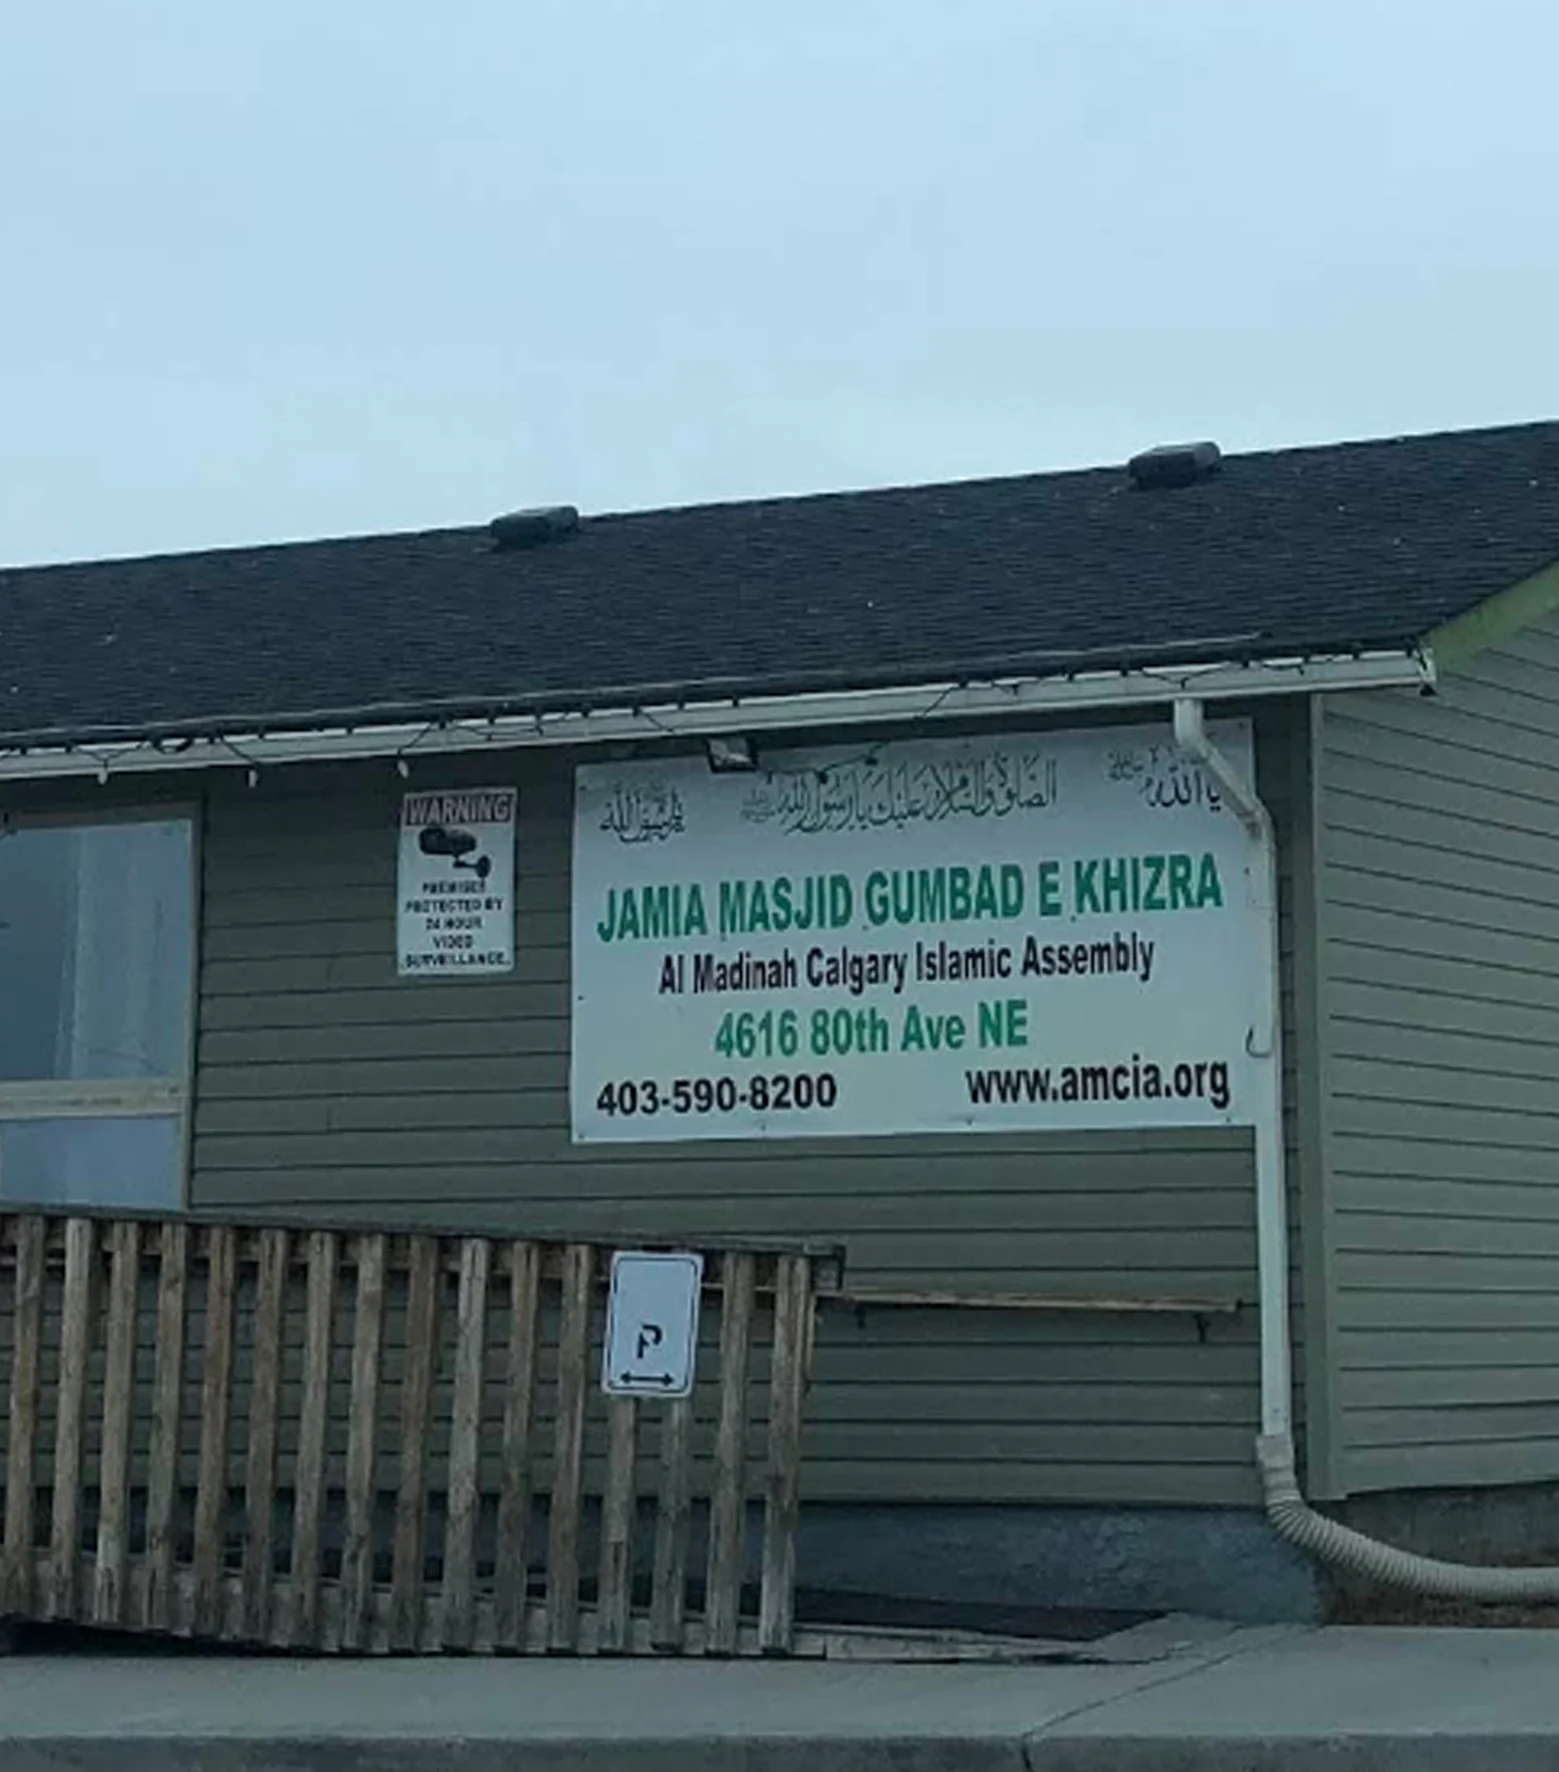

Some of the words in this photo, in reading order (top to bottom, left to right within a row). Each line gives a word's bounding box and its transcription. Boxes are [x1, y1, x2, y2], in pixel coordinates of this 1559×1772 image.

[410, 796, 509, 824] WARNING
[405, 899, 481, 914] PROTECTED
[485, 897, 504, 911] BY
[597, 883, 708, 943] JAMIA
[719, 874, 853, 934] MASJID
[865, 863, 1025, 926] GUMBAD
[1039, 861, 1063, 917] E
[1074, 852, 1224, 914] KHIZRA
[433, 934, 474, 949] VIDEO
[444, 916, 483, 930] HOUR
[659, 953, 685, 995] Al
[693, 947, 798, 995] Madinah
[806, 945, 908, 997] Calgary
[916, 938, 1012, 982] Islamic
[1021, 931, 1155, 983] Assembly
[715, 1009, 799, 1059] 4616
[810, 1006, 890, 1056] 80th
[900, 1004, 966, 1051] Ave
[978, 999, 1028, 1048] NE
[597, 1073, 838, 1117] 403-590-8200
[965, 1053, 1231, 1110] www.amcia.org
[637, 1324, 663, 1359] P
